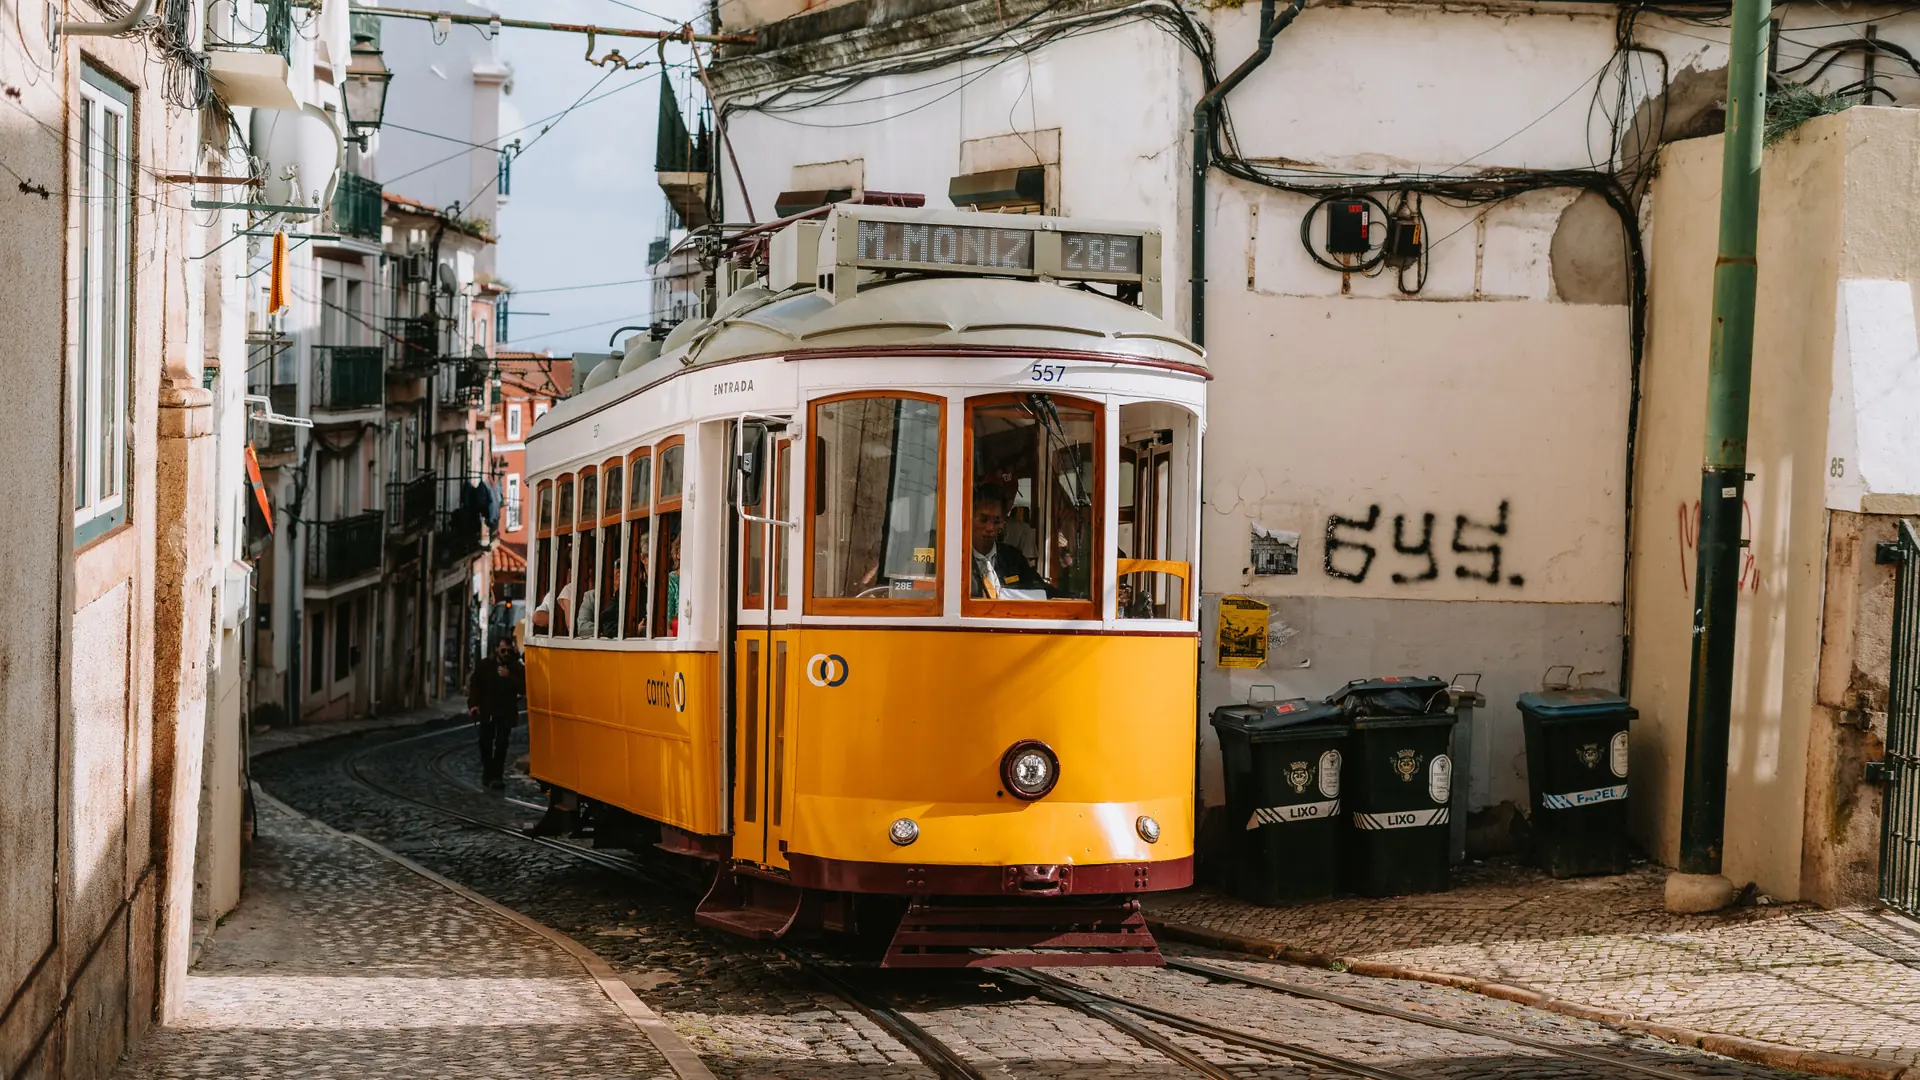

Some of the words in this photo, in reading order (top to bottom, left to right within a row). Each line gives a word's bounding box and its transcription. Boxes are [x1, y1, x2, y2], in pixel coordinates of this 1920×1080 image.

[857, 221, 1027, 269] M.MONIZ
[1067, 237, 1127, 271] 28E
[1031, 364, 1066, 382] 557
[713, 379, 754, 396] ENTRADA
[1830, 456, 1845, 479] 85
[913, 554, 931, 563] 3.20
[895, 581, 912, 591] 28E
[646, 669, 671, 709] carris
[1289, 805, 1318, 819] LIXO
[1387, 813, 1416, 826] LIXO
